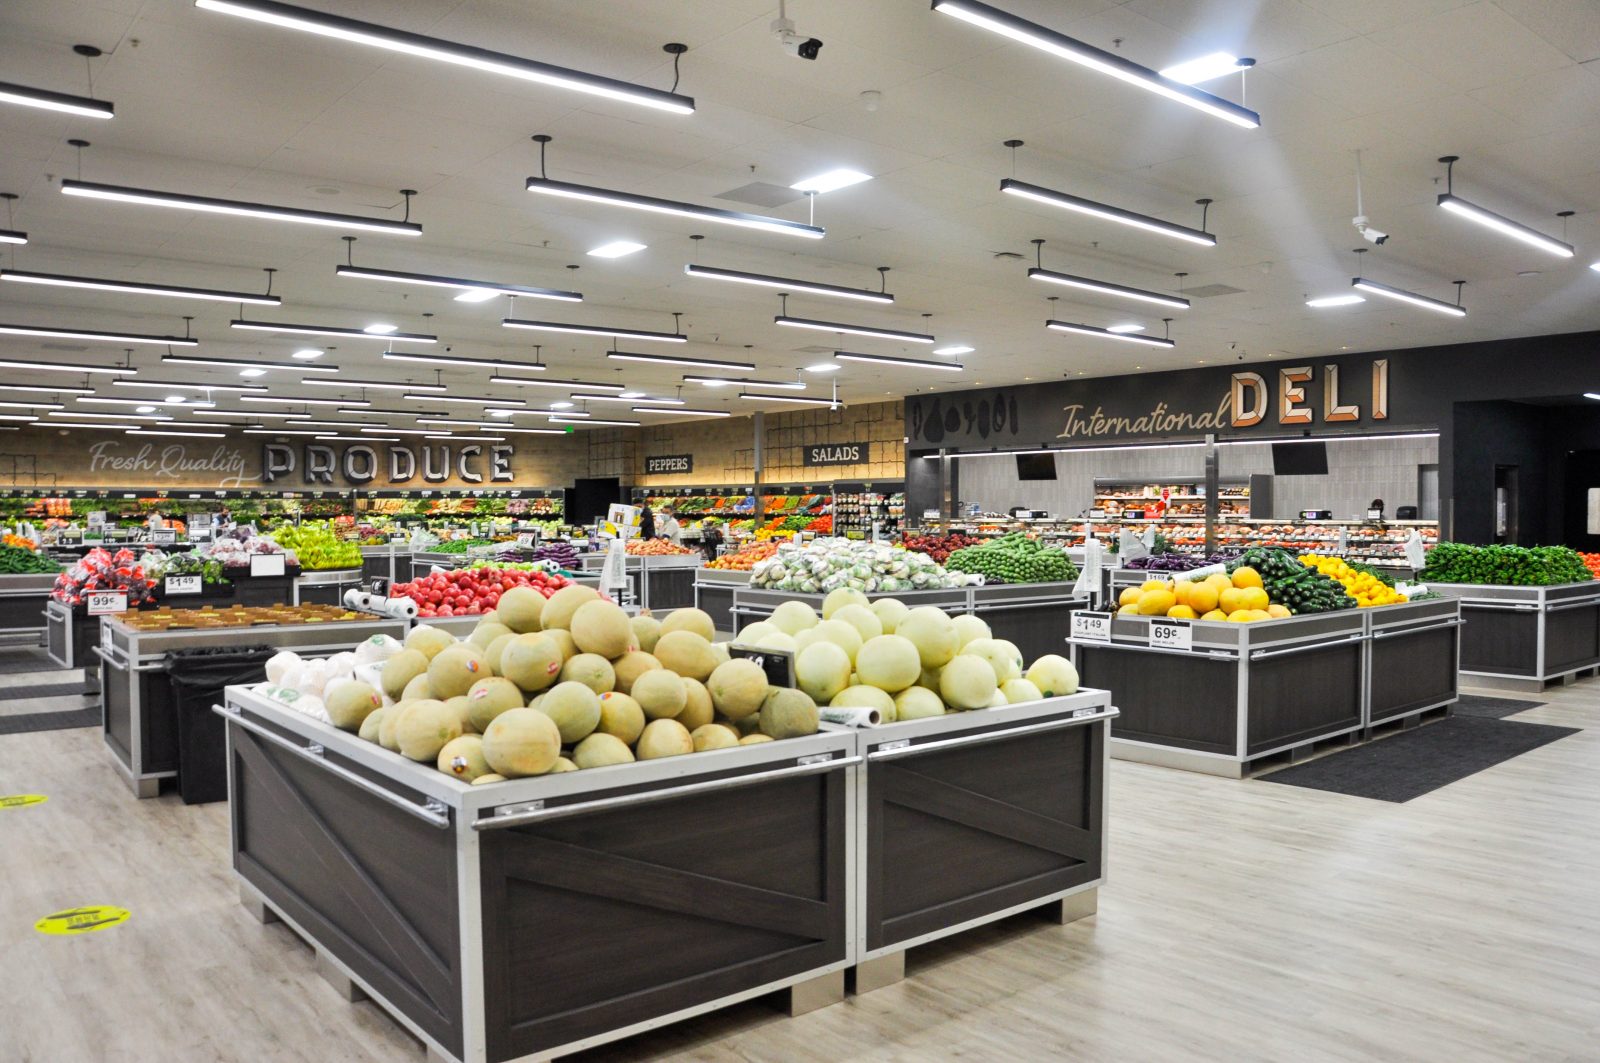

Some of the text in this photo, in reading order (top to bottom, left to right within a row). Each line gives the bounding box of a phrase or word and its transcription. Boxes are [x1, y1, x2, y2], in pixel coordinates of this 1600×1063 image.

[1056, 358, 1388, 438] International DELI
[89, 441, 515, 488] Fresh Quality PRODUCE
[649, 457, 688, 471] PEPPERS
[811, 446, 860, 462] SALADS
